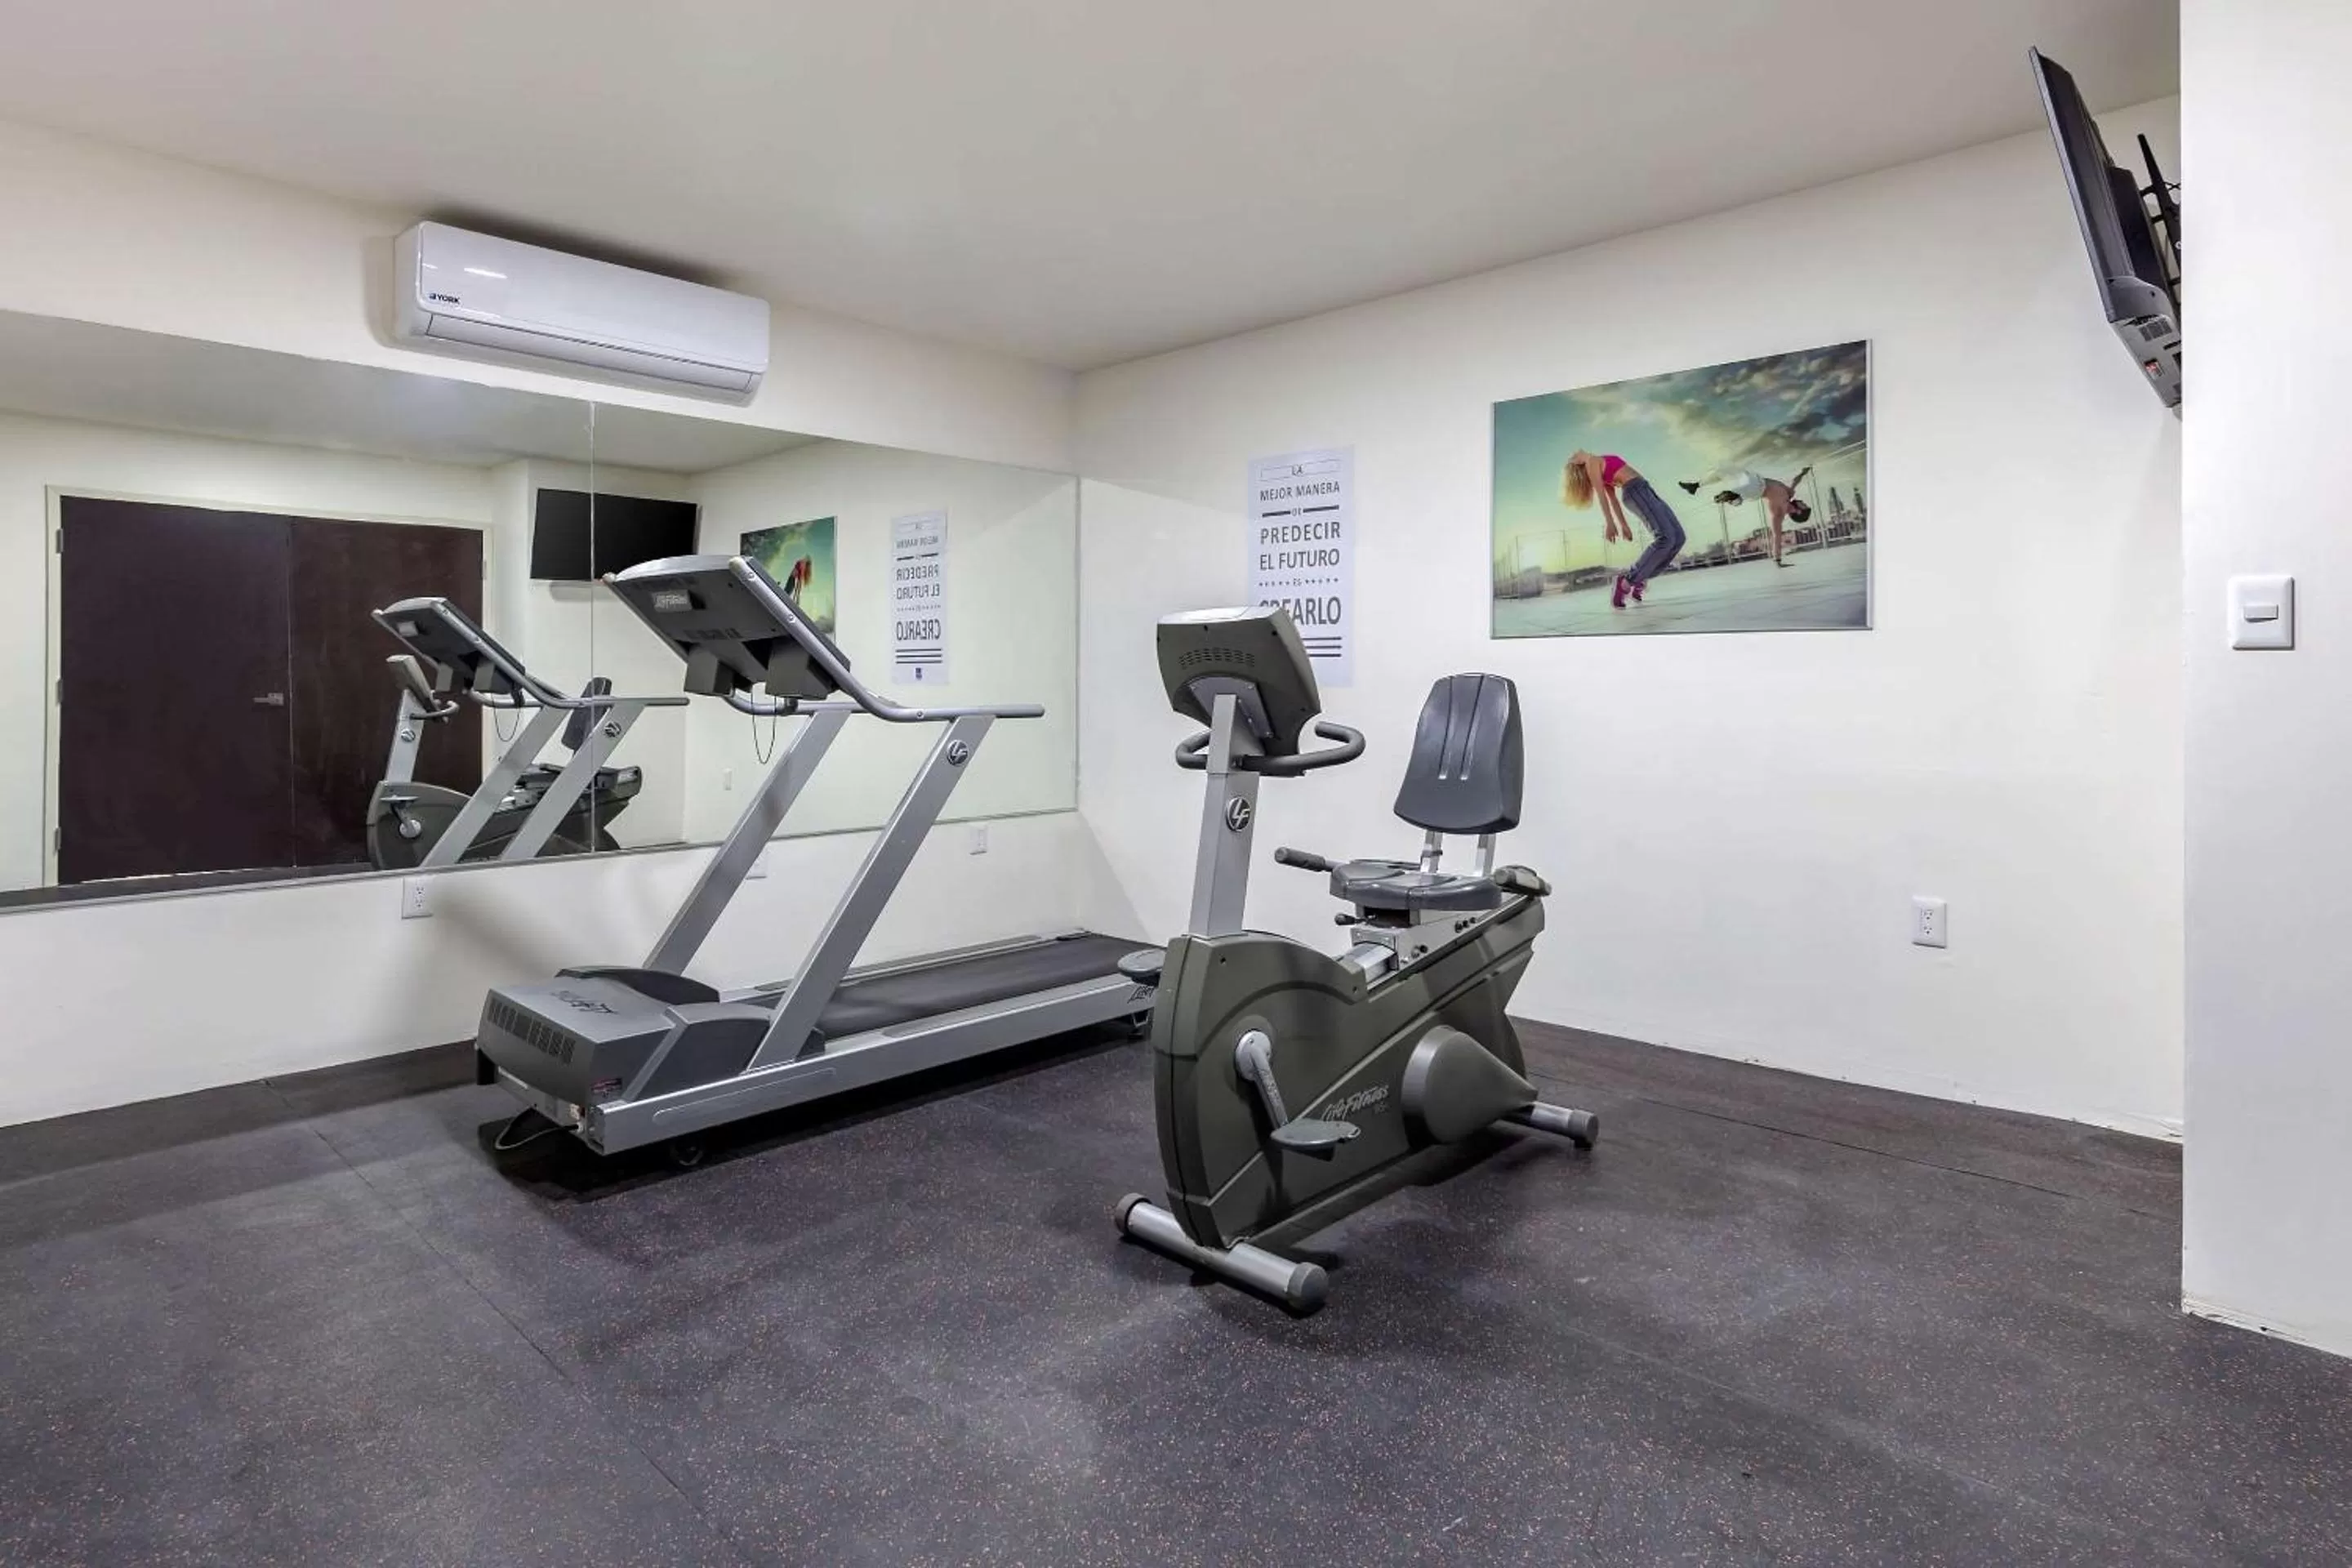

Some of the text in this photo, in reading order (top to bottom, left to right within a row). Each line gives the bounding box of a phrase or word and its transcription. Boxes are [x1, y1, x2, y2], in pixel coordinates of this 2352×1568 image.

[437, 293, 460, 305] YORK
[1291, 466, 1304, 476] LA
[1260, 480, 1340, 501] MEJOR MANERA
[1260, 521, 1341, 545] PREDECIR
[1260, 548, 1340, 571] EL FUTURO
[1259, 596, 1342, 626] ARLO
